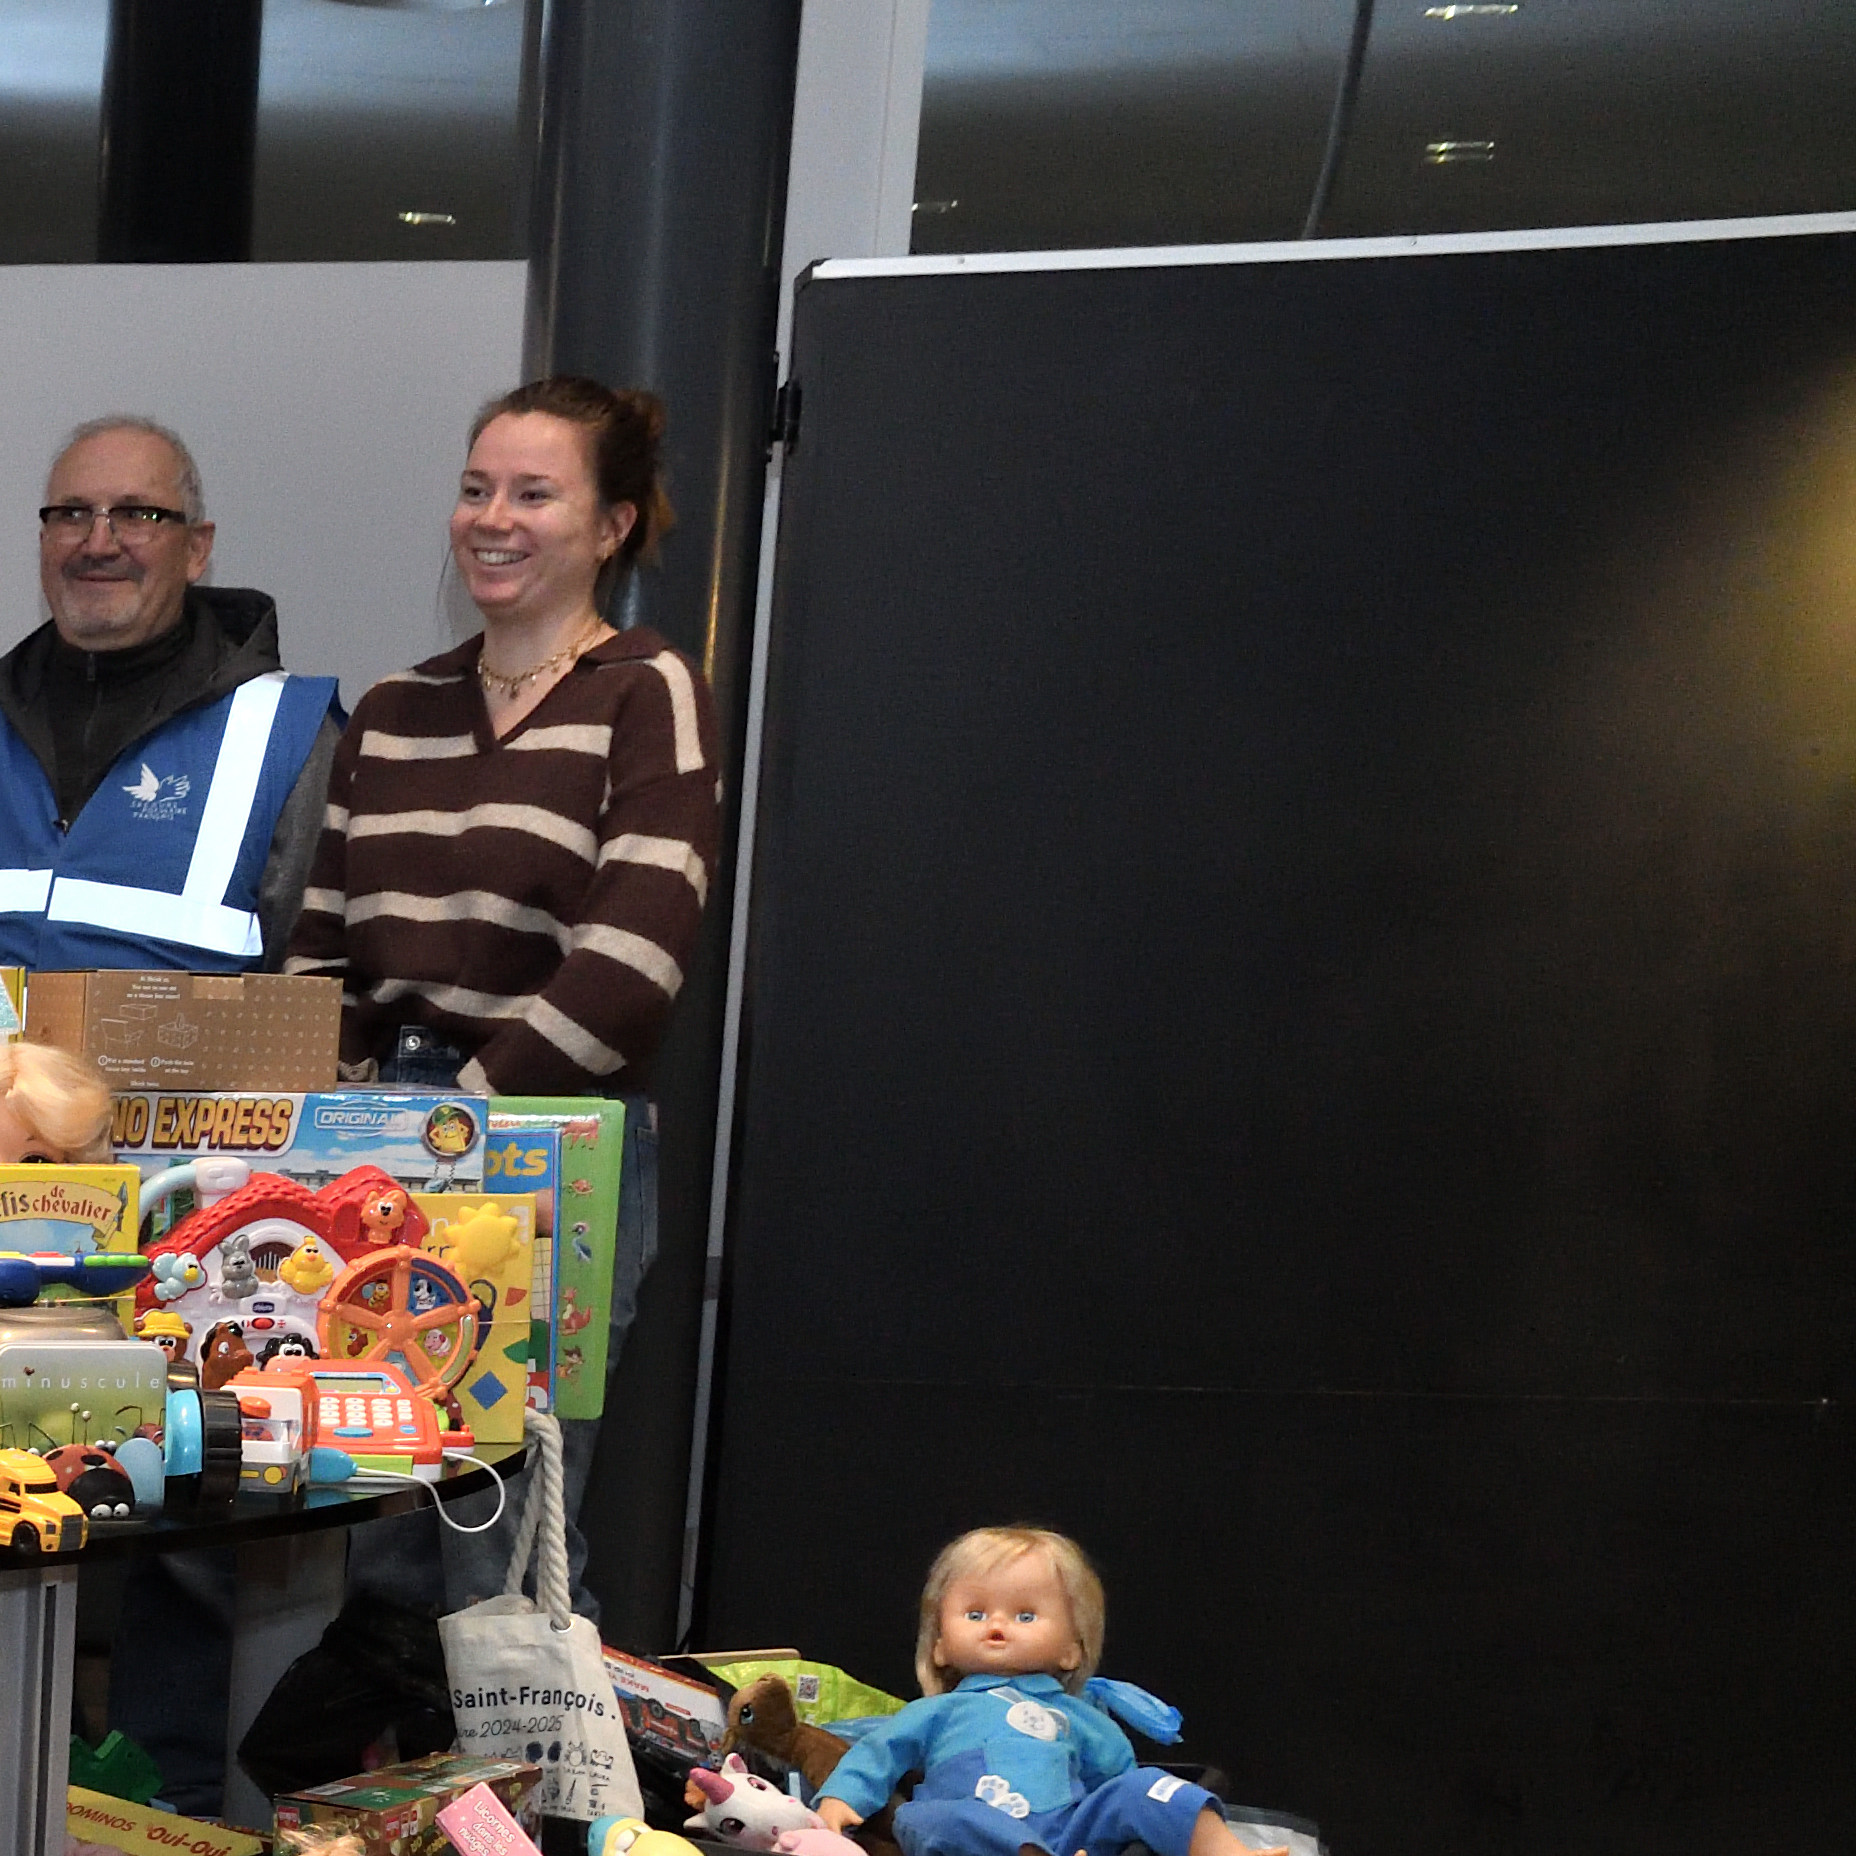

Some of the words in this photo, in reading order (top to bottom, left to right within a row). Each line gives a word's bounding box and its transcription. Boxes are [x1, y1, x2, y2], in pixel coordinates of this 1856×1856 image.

[153, 1094, 293, 1153] EXPRESS
[32, 1199, 114, 1223] chevalier
[1, 1366, 162, 1391] minuscule
[454, 1686, 606, 1716] Saint-François
[479, 1715, 563, 1740] 2024-2025
[471, 1821, 496, 1848] dans
[473, 1799, 517, 1845] Licornes
